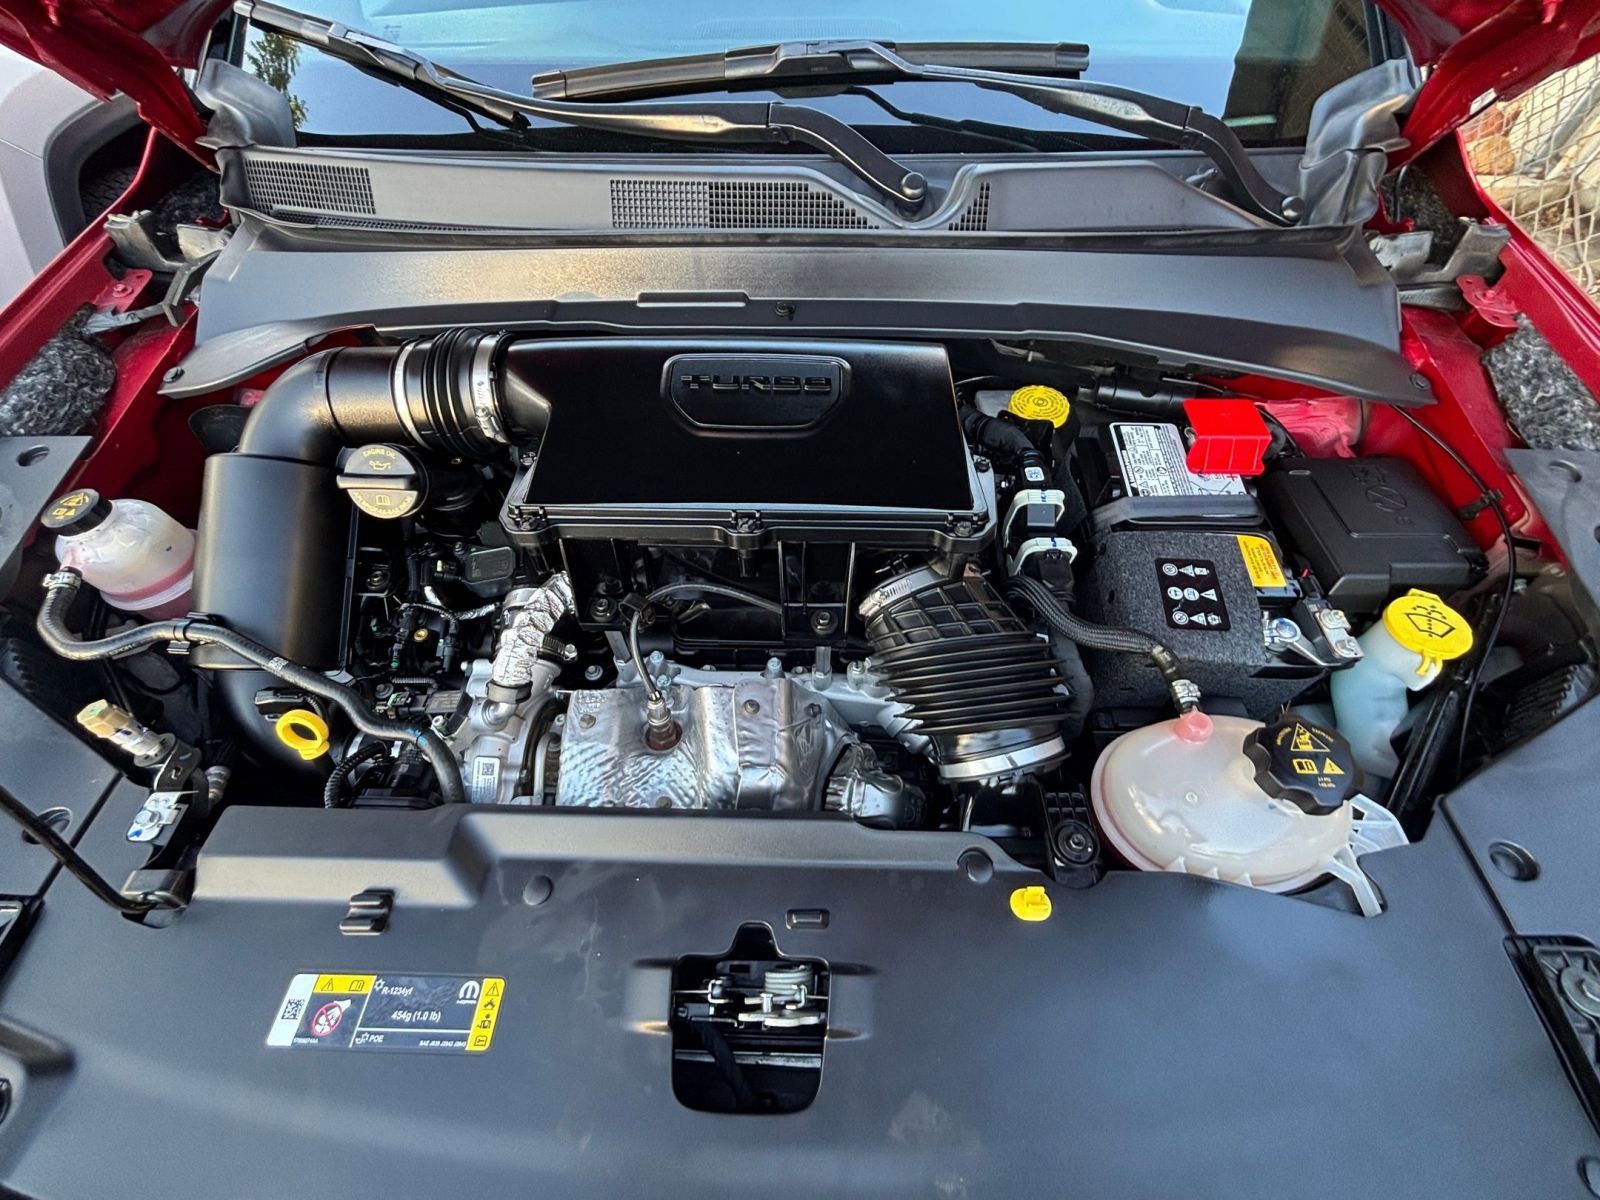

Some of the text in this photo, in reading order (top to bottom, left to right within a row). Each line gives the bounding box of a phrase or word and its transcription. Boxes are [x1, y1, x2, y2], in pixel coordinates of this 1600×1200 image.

[363, 448, 396, 459] ENGINE OIL
[381, 986, 413, 997] R-1234yf
[391, 1010, 442, 1023] 454g (1.0 lb)
[368, 1034, 384, 1043] POE
